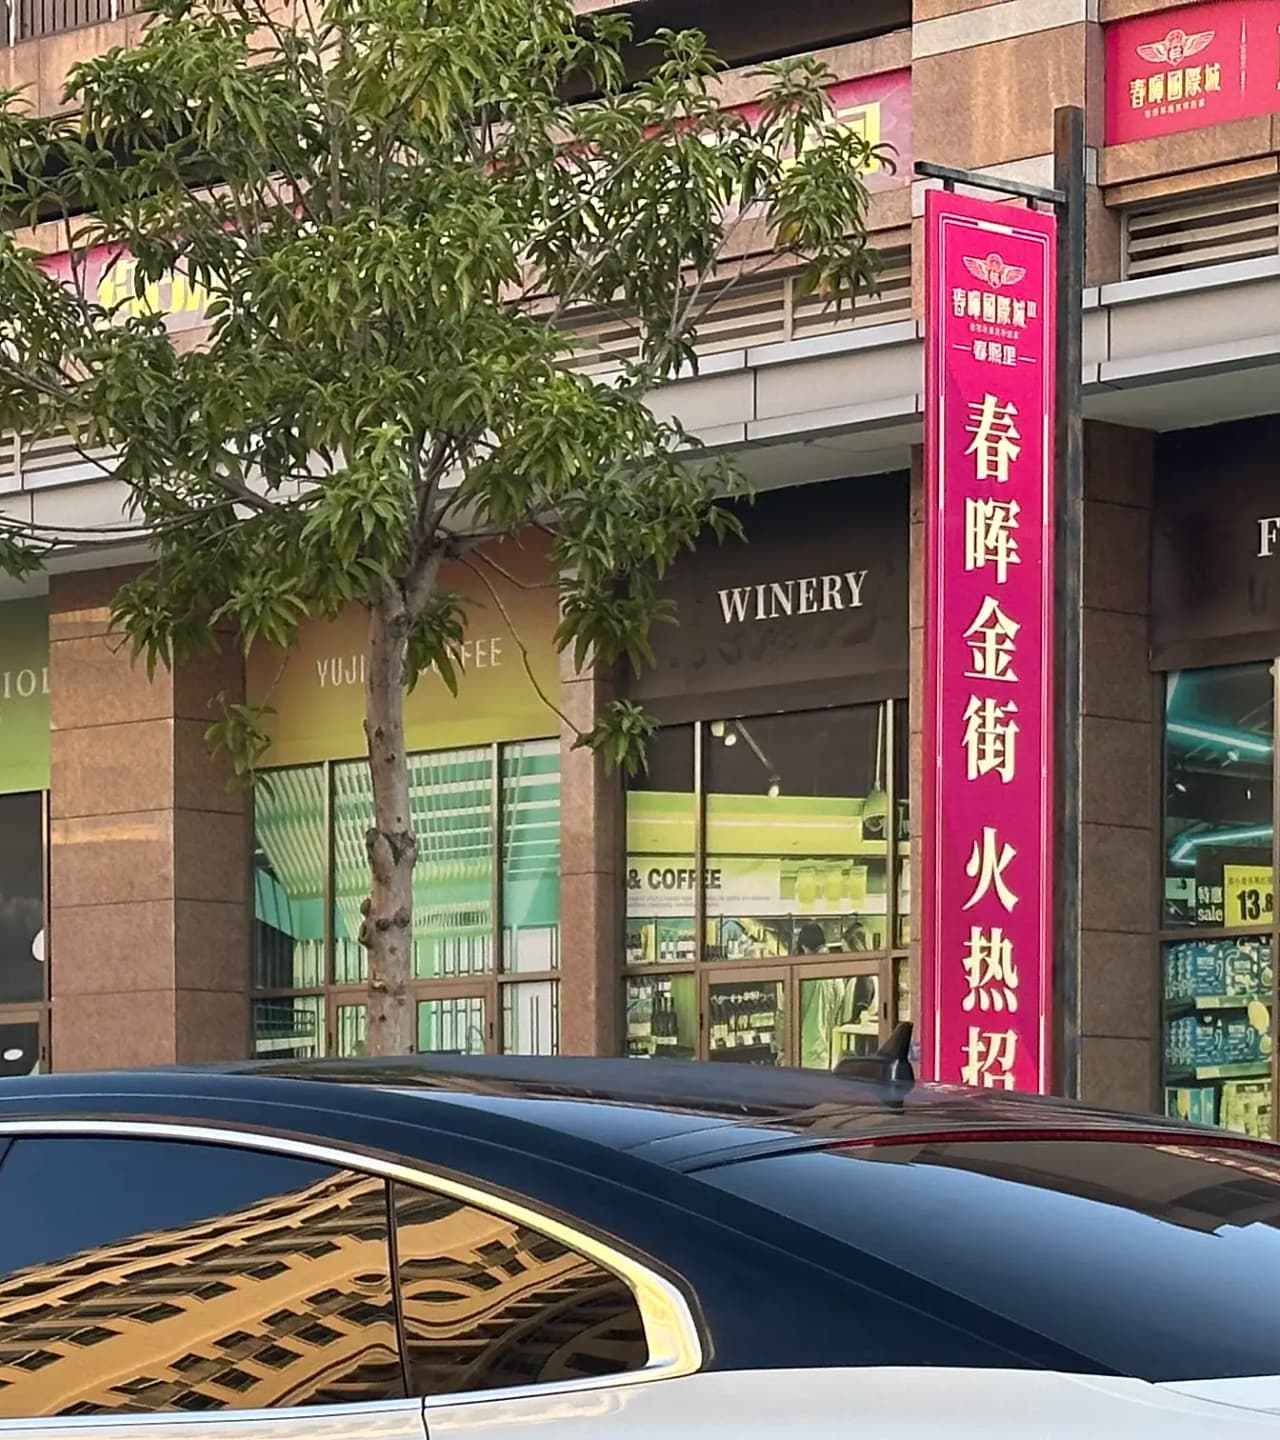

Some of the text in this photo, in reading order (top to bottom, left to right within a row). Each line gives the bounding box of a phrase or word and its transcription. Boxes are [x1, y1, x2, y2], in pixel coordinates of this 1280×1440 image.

[718, 569, 869, 624] WINERY
[962, 392, 1021, 785] 春晖金街
[417, 637, 503, 677] FFEE
[647, 868, 722, 890] COFFE
[1197, 905, 1223, 922] sale
[961, 826, 1019, 1092] 火热招
